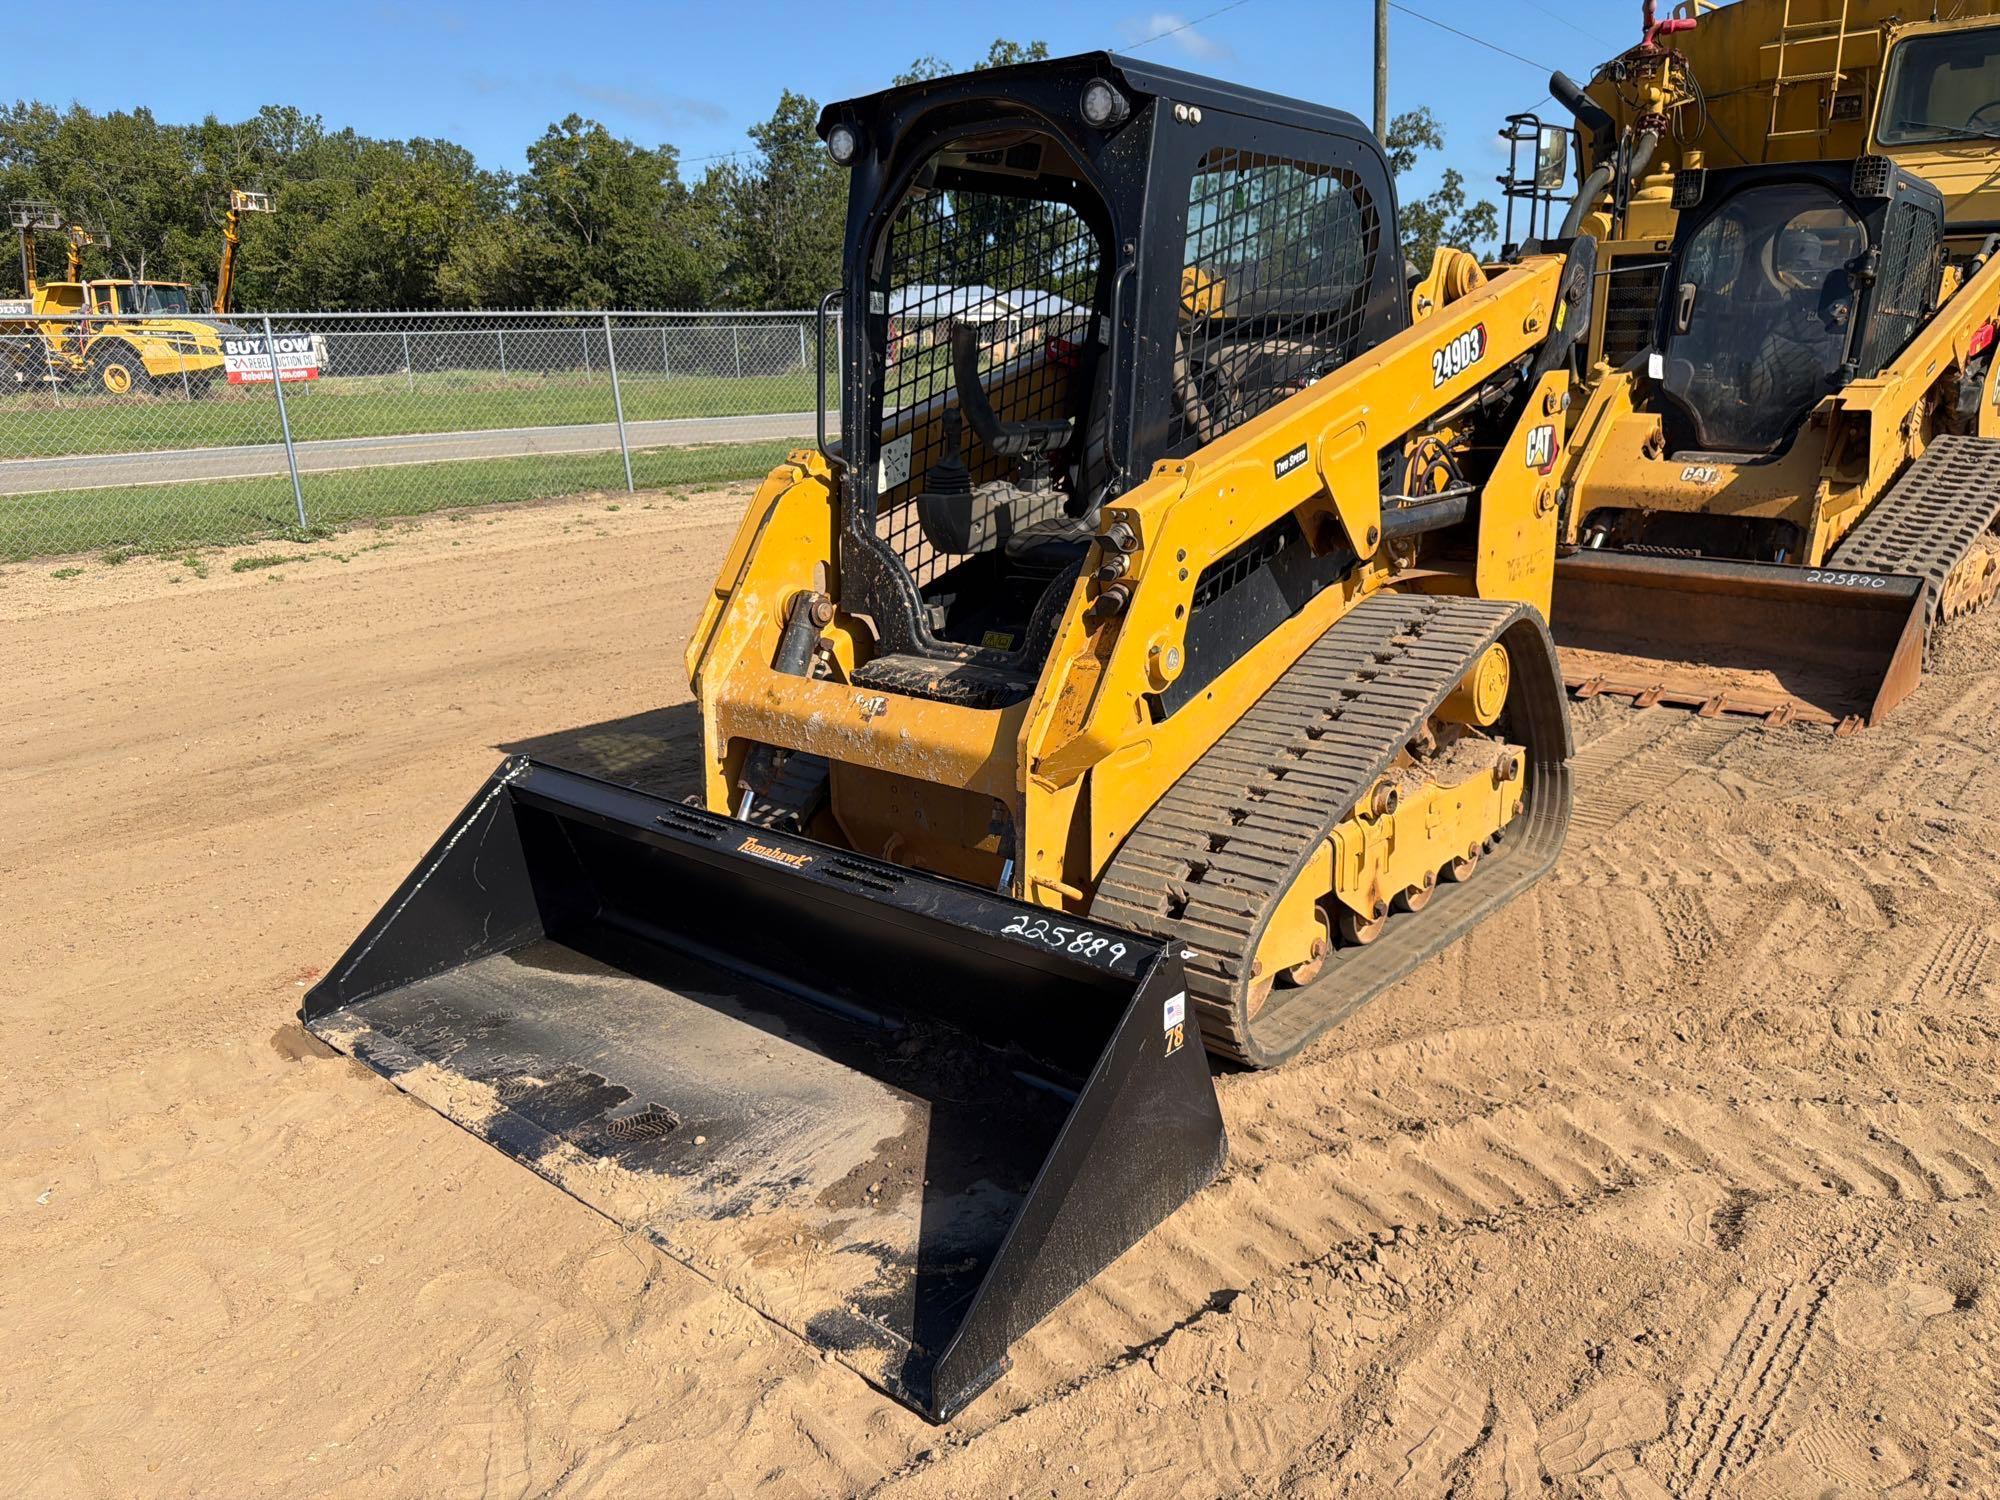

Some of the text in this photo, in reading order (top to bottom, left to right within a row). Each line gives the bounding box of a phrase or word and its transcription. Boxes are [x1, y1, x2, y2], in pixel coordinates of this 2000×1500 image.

[226, 338, 309, 355] BUY NOW
[1432, 327, 1480, 388] 249D3
[248, 357, 272, 369] REBEL
[274, 355, 304, 368] UCTION
[1526, 426, 1552, 467] CAT
[1681, 467, 1717, 482] CAT
[1807, 570, 1885, 588] 225890
[736, 836, 813, 867] Tomahawk
[1000, 915, 1127, 968] 225889
[1165, 1023, 1184, 1053] 78
